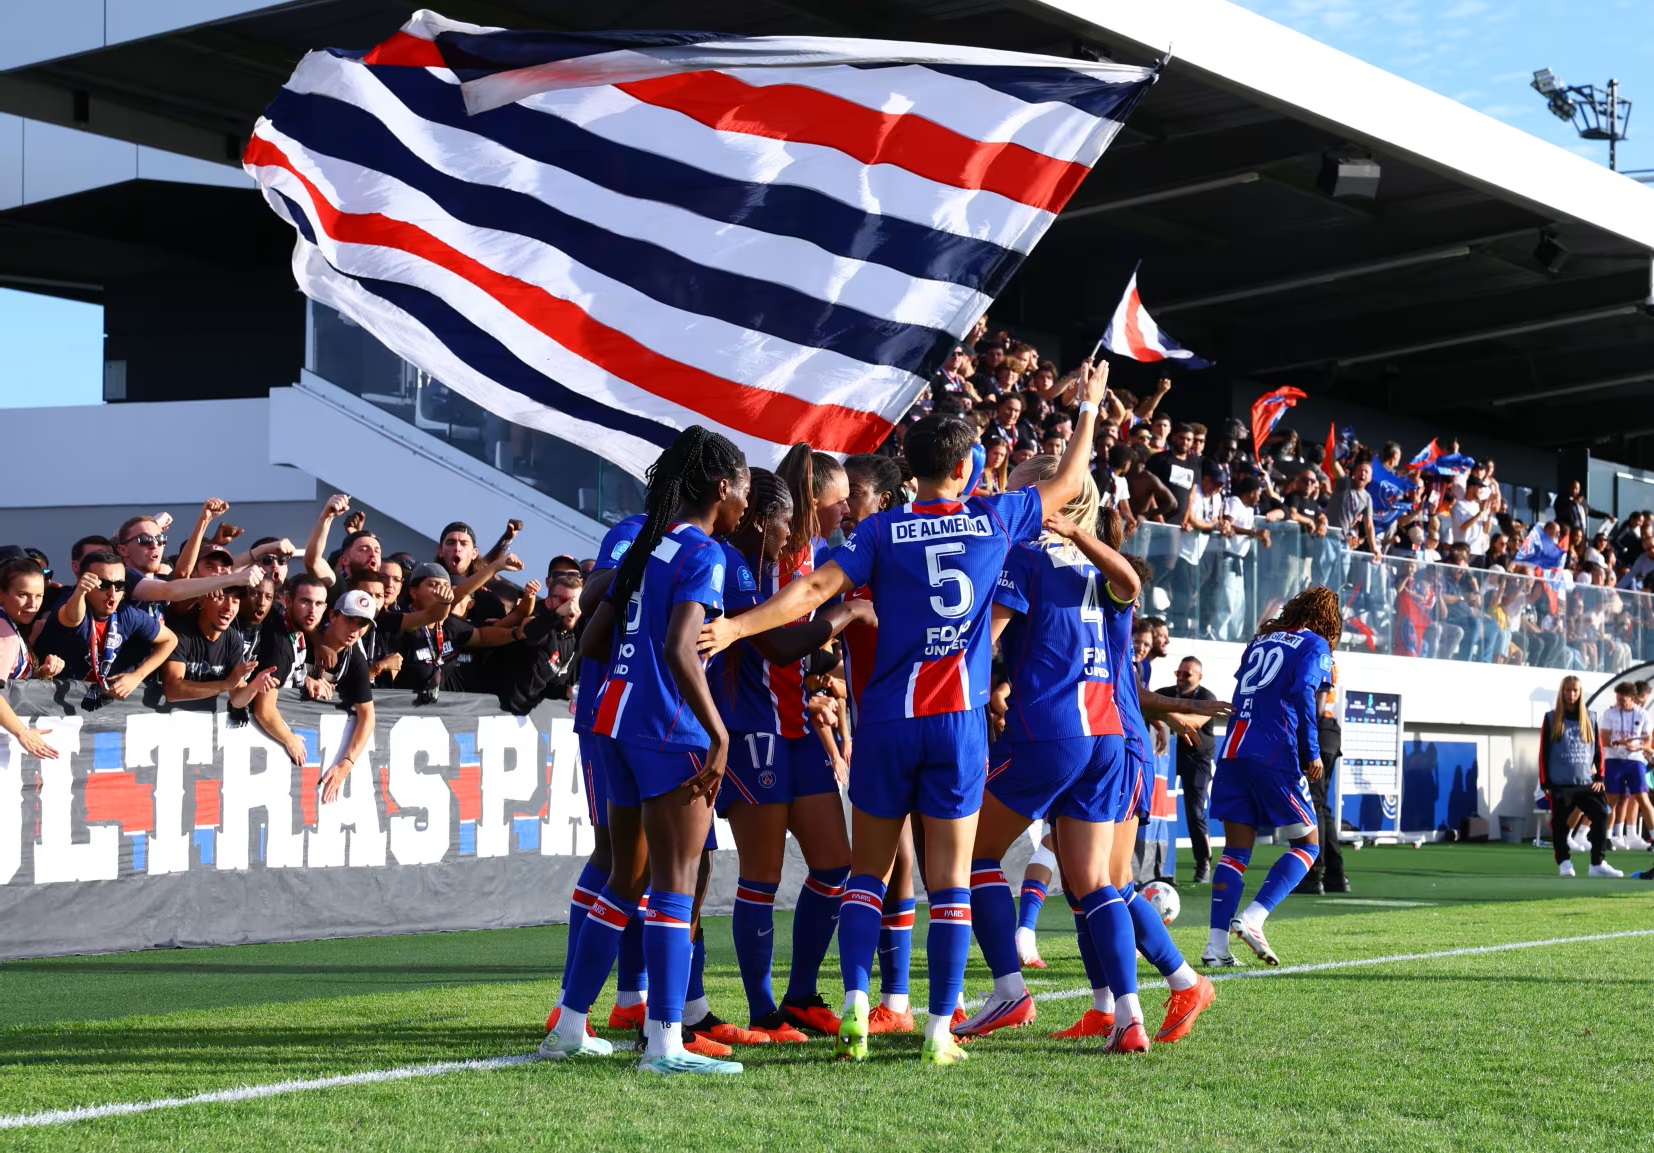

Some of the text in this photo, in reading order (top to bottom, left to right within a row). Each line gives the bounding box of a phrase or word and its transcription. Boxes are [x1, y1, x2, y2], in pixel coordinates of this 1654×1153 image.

[896, 523, 917, 539] DE
[925, 541, 974, 619] 5
[1080, 569, 1103, 642] 4
[1240, 645, 1284, 695] 20
[745, 731, 775, 769] 17
[851, 892, 871, 902] PARIS
[944, 909, 964, 917] PARIS
[660, 1020, 671, 1029] 18
